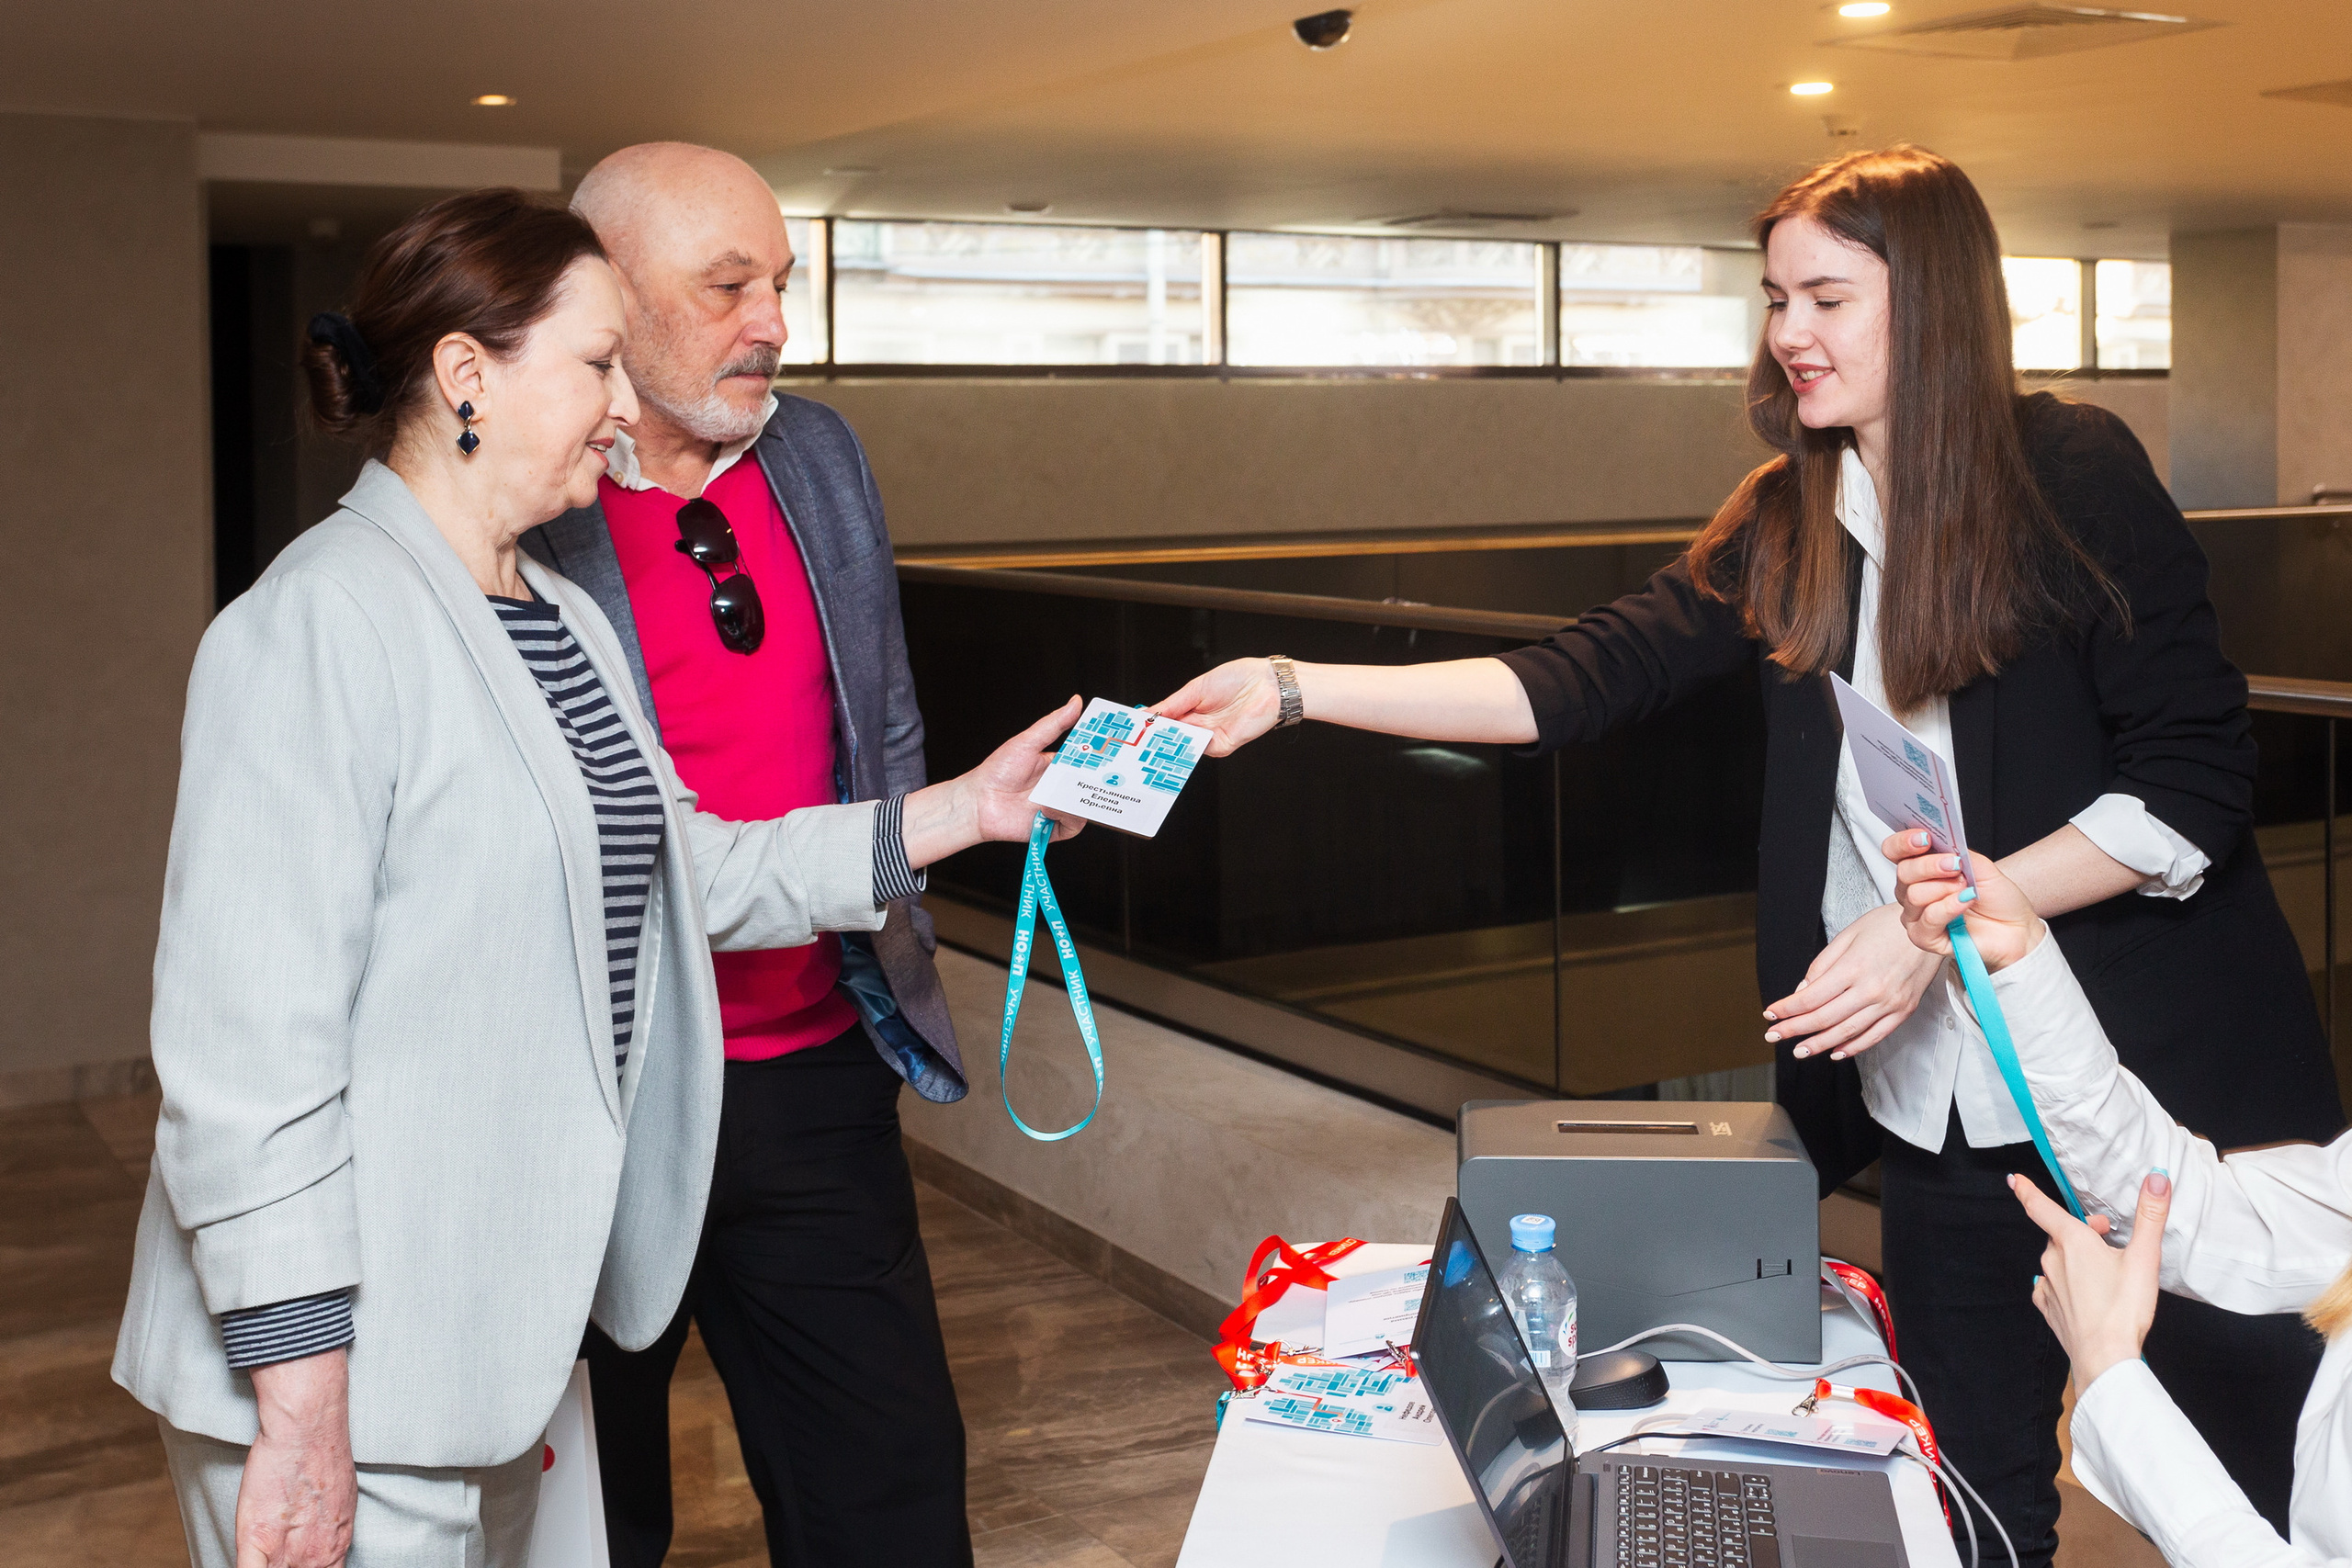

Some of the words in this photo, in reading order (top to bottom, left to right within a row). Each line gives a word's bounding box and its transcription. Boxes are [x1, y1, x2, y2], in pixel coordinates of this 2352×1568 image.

[1077, 781, 1141, 804] Крестьянцева
[1080, 797, 1123, 814] Юрьевна
[1091, 793, 1119, 806] Елена
[1031, 841, 1056, 911] УЧАСТНИК
[1068, 969, 1096, 1045] УЧАСТНИК
[1908, 1418, 1937, 1483] СИКЕР
